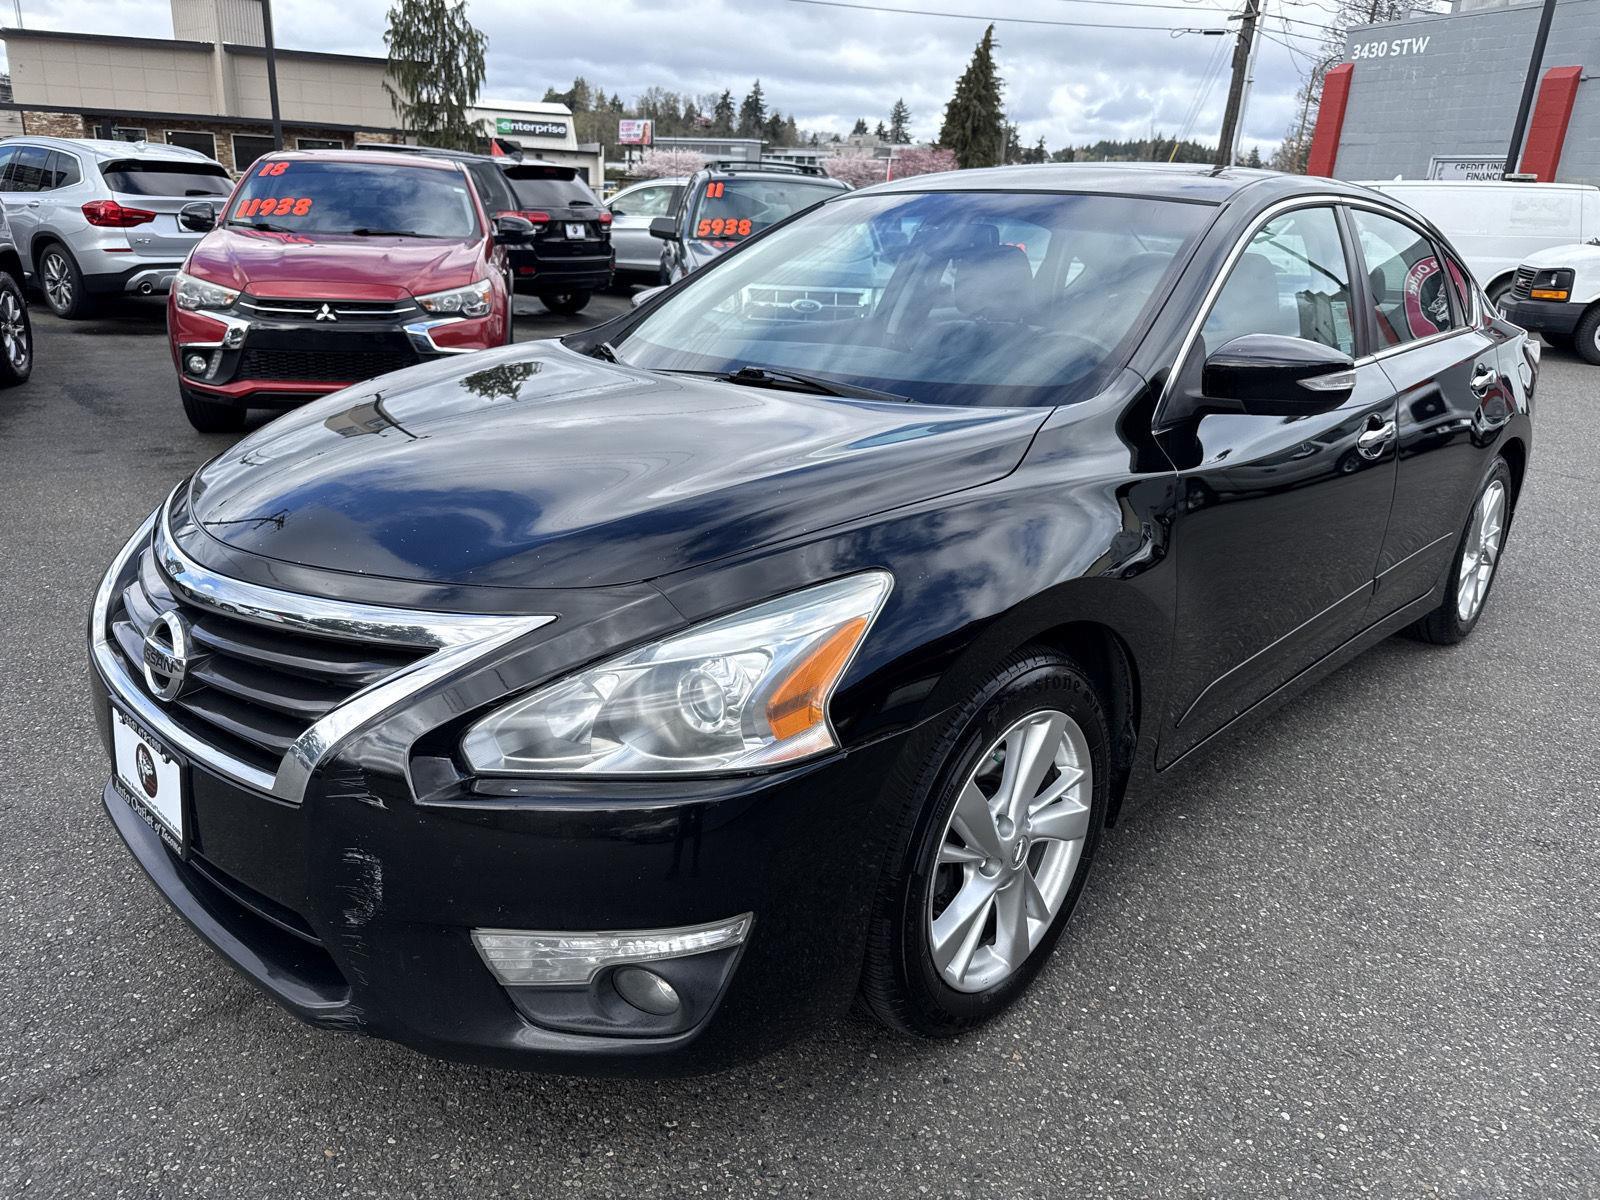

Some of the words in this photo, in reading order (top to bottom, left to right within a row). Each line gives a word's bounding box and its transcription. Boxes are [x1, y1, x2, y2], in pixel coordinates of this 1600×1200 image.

[1351, 41, 1388, 60] 3430
[1390, 36, 1431, 57] STW
[499, 121, 567, 134] enterprise
[258, 161, 290, 177] 18
[1454, 163, 1485, 171] CREDIT
[1486, 163, 1507, 171] UNIO
[1466, 172, 1505, 181] FINANCI
[706, 182, 725, 198] 11
[235, 197, 313, 219] 11938
[697, 217, 752, 237] 5938
[145, 647, 174, 674] SSAN
[114, 779, 131, 805] Auto
[131, 797, 154, 829] Outlet
